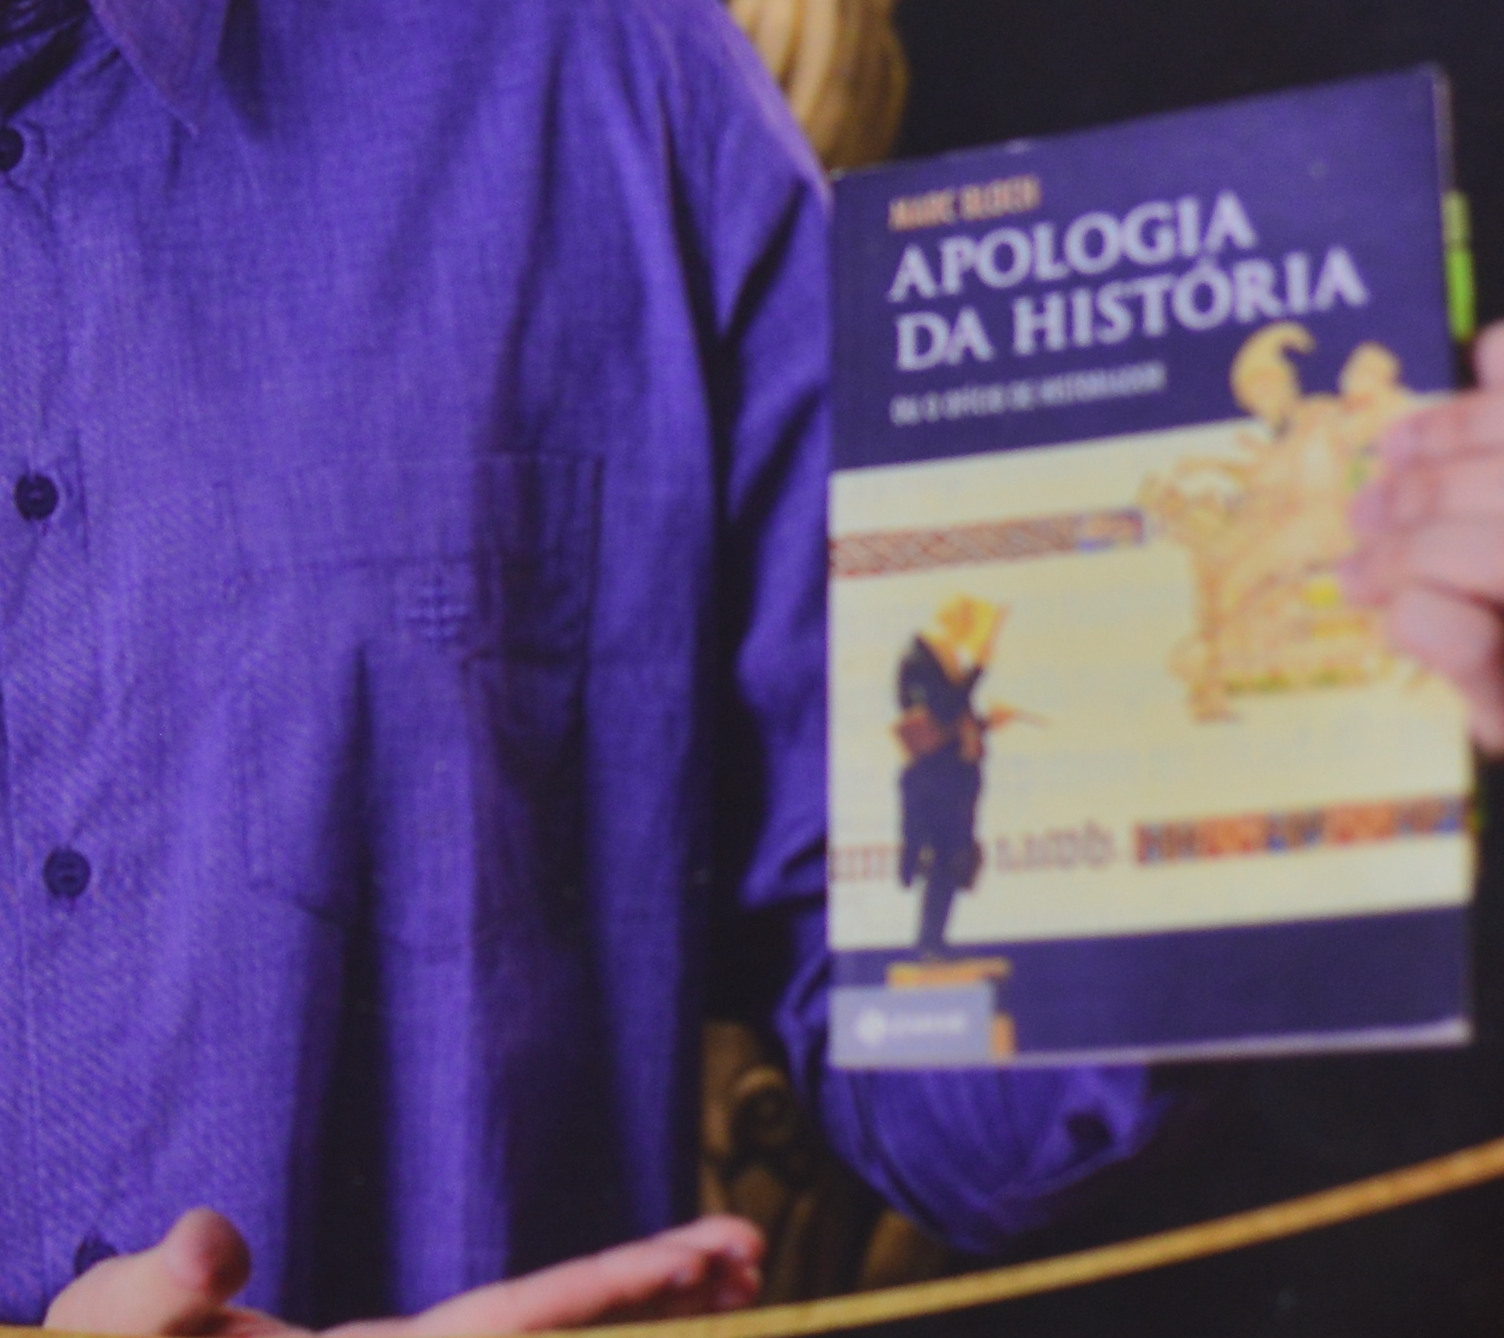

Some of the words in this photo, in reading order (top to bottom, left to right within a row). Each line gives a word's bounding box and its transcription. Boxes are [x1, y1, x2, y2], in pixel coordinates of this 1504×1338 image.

[888, 191, 1256, 302] APOLOGIA
[896, 307, 993, 370] DA
[1012, 246, 1368, 356] HISTÓRIA
